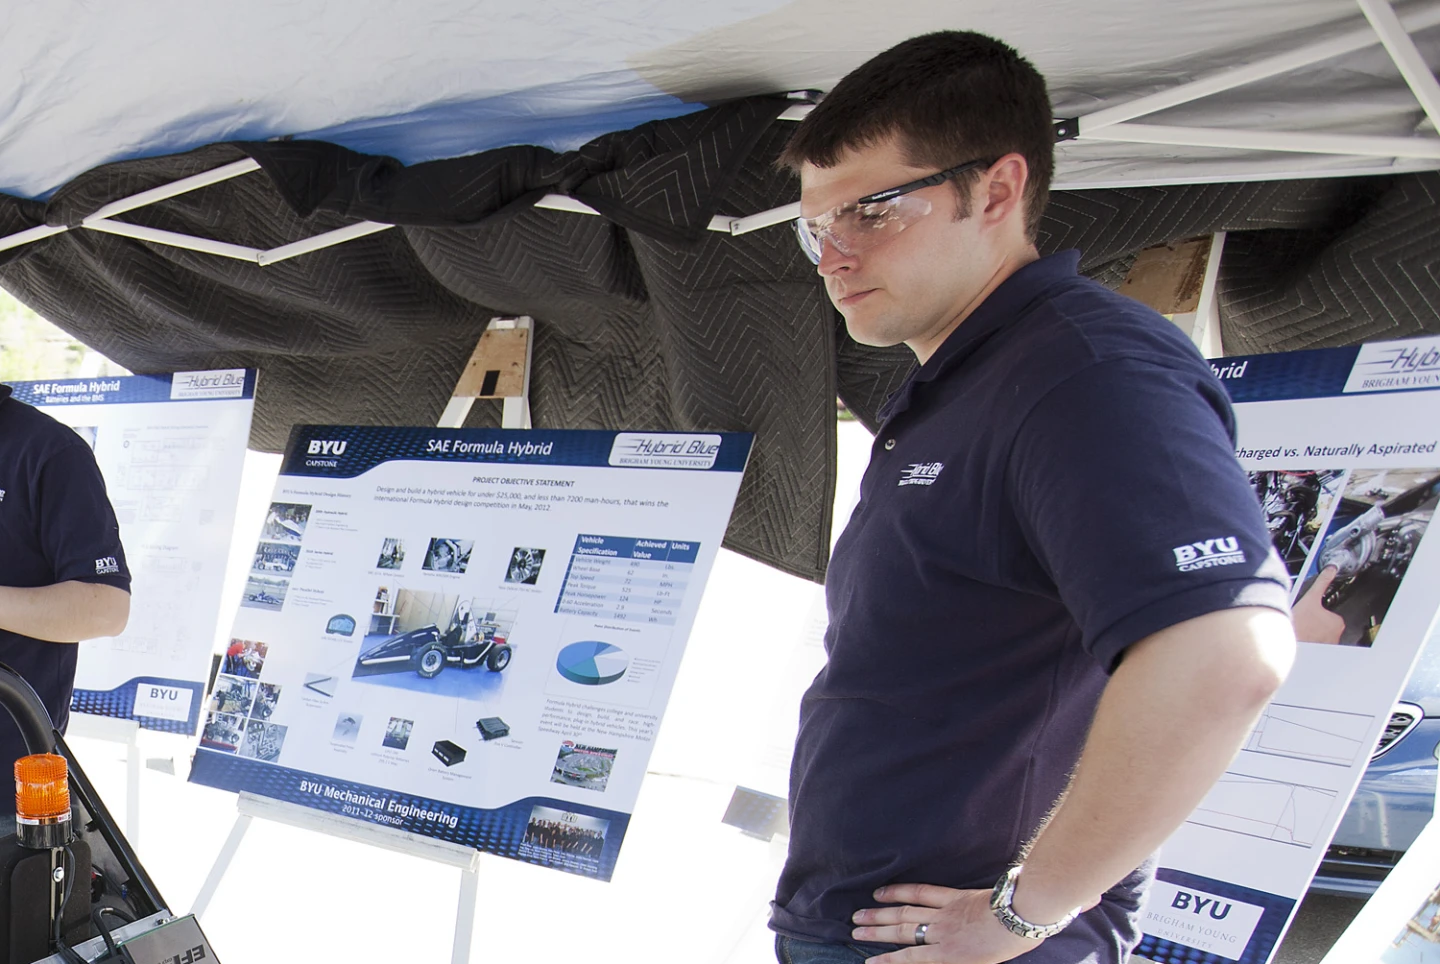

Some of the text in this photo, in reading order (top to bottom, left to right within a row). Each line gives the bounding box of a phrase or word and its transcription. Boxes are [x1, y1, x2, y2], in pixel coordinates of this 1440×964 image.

[33, 380, 120, 394] SAE Formula Hybrid
[189, 373, 244, 389] Hybrid Blue
[1362, 377, 1410, 388] BRIGHAM
[308, 440, 347, 455] BYU
[426, 439, 553, 457] SAE Formula Hybrid
[636, 439, 720, 456] Hybrid Blue
[1234, 441, 1438, 460] charged vs. Naturally Aspirated
[650, 458, 672, 466] YOUNG
[673, 459, 711, 467] UNIVERSITY
[472, 476, 575, 488] PROJECT OBJECTIVE STATEMENT
[376, 485, 395, 494] Design
[426, 488, 445, 496] hybrid
[446, 489, 466, 497] vehicle
[467, 490, 477, 498] for
[537, 493, 549, 501] less
[566, 495, 583, 503] 7200
[656, 500, 669, 508] the
[433, 498, 453, 506] Hybrid
[454, 499, 472, 508] design
[473, 500, 510, 509] competition
[581, 536, 690, 550] Vehicle Achieved Units
[1172, 536, 1239, 563] BYU
[577, 546, 652, 559] Specification Value
[95, 557, 117, 567] BYU
[1178, 555, 1247, 572] CAPSTONE
[150, 688, 178, 701] BYU
[300, 780, 459, 828] BYU Mechanical Engineering
[341, 804, 404, 826] 2011-12 sponsor
[1171, 890, 1232, 920] BYU
[1146, 911, 1237, 944] BRIGHAM YOUNG
[1157, 928, 1213, 949] UNIVERSITY
